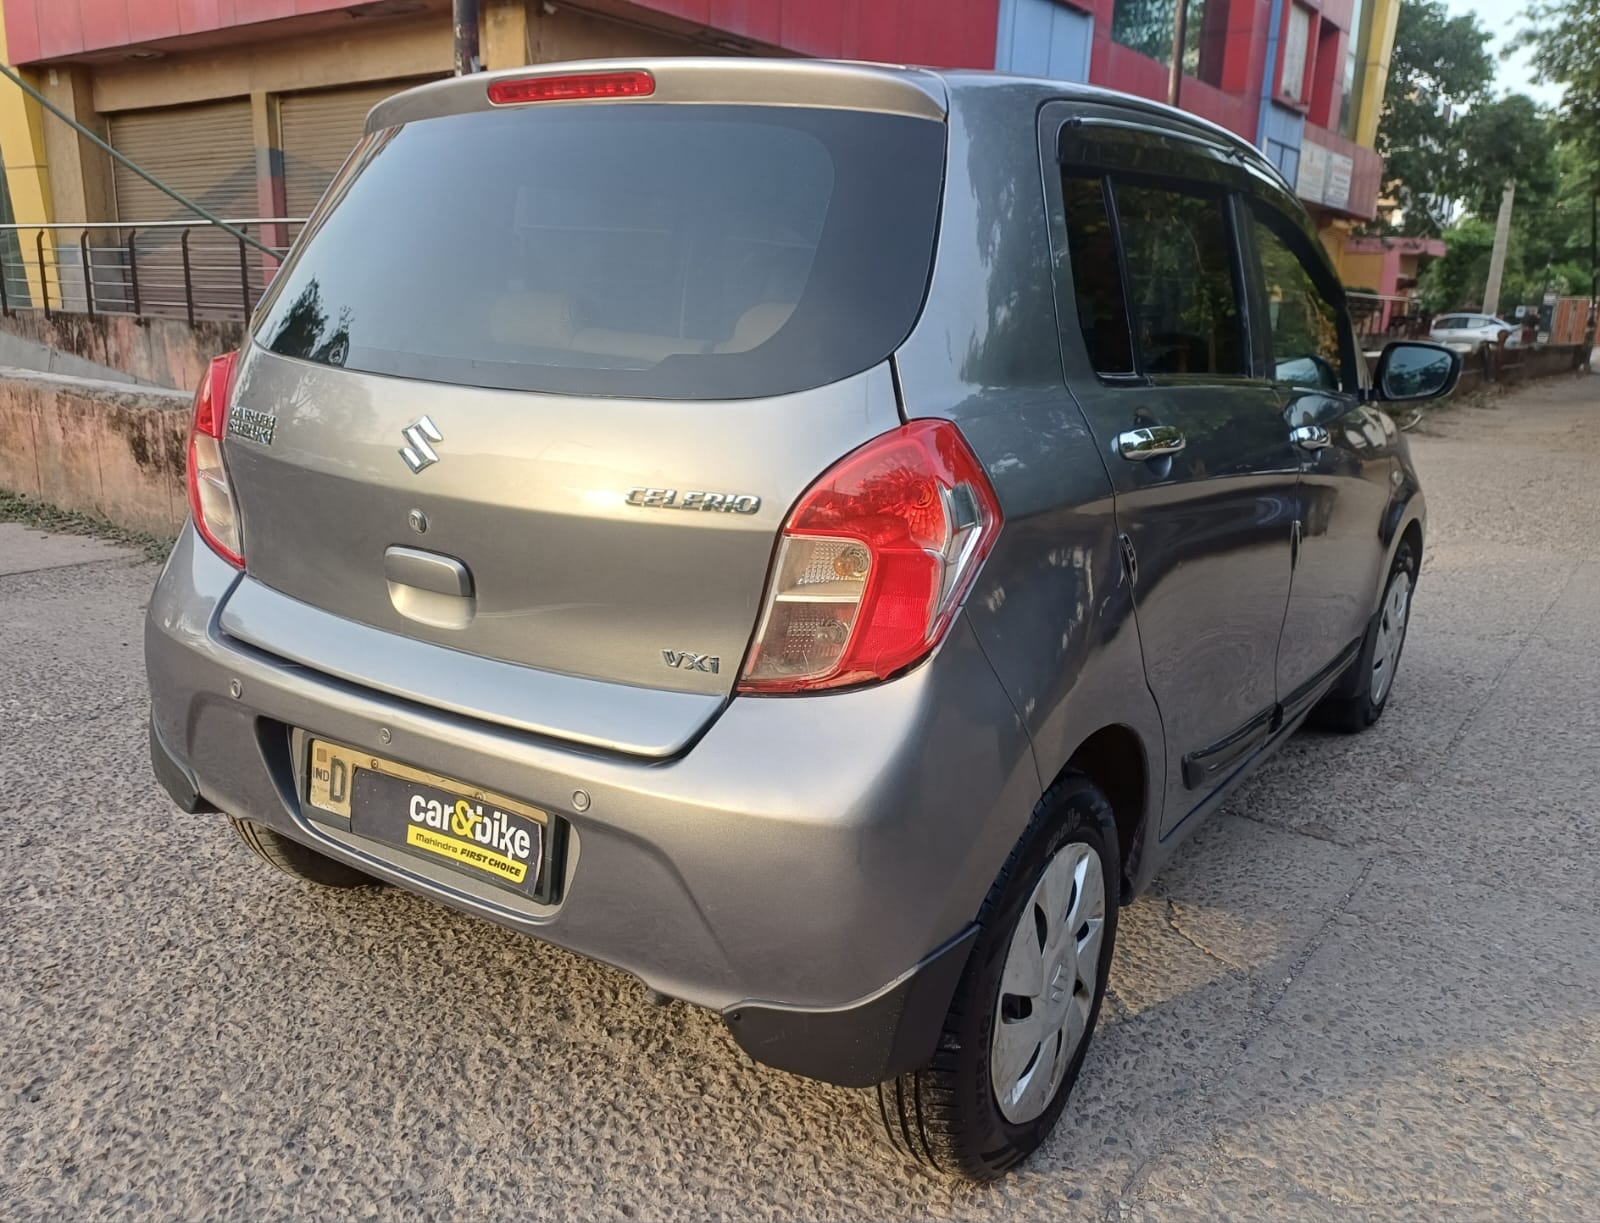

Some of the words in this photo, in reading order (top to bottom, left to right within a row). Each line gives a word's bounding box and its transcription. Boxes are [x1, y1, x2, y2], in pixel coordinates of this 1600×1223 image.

[229, 419, 272, 445] SUZUKI
[625, 487, 761, 515] CELERIO
[312, 767, 330, 782] IND
[409, 795, 531, 861] car&bike
[460, 847, 489, 864] FIRST
[488, 857, 522, 877] CHOICE
